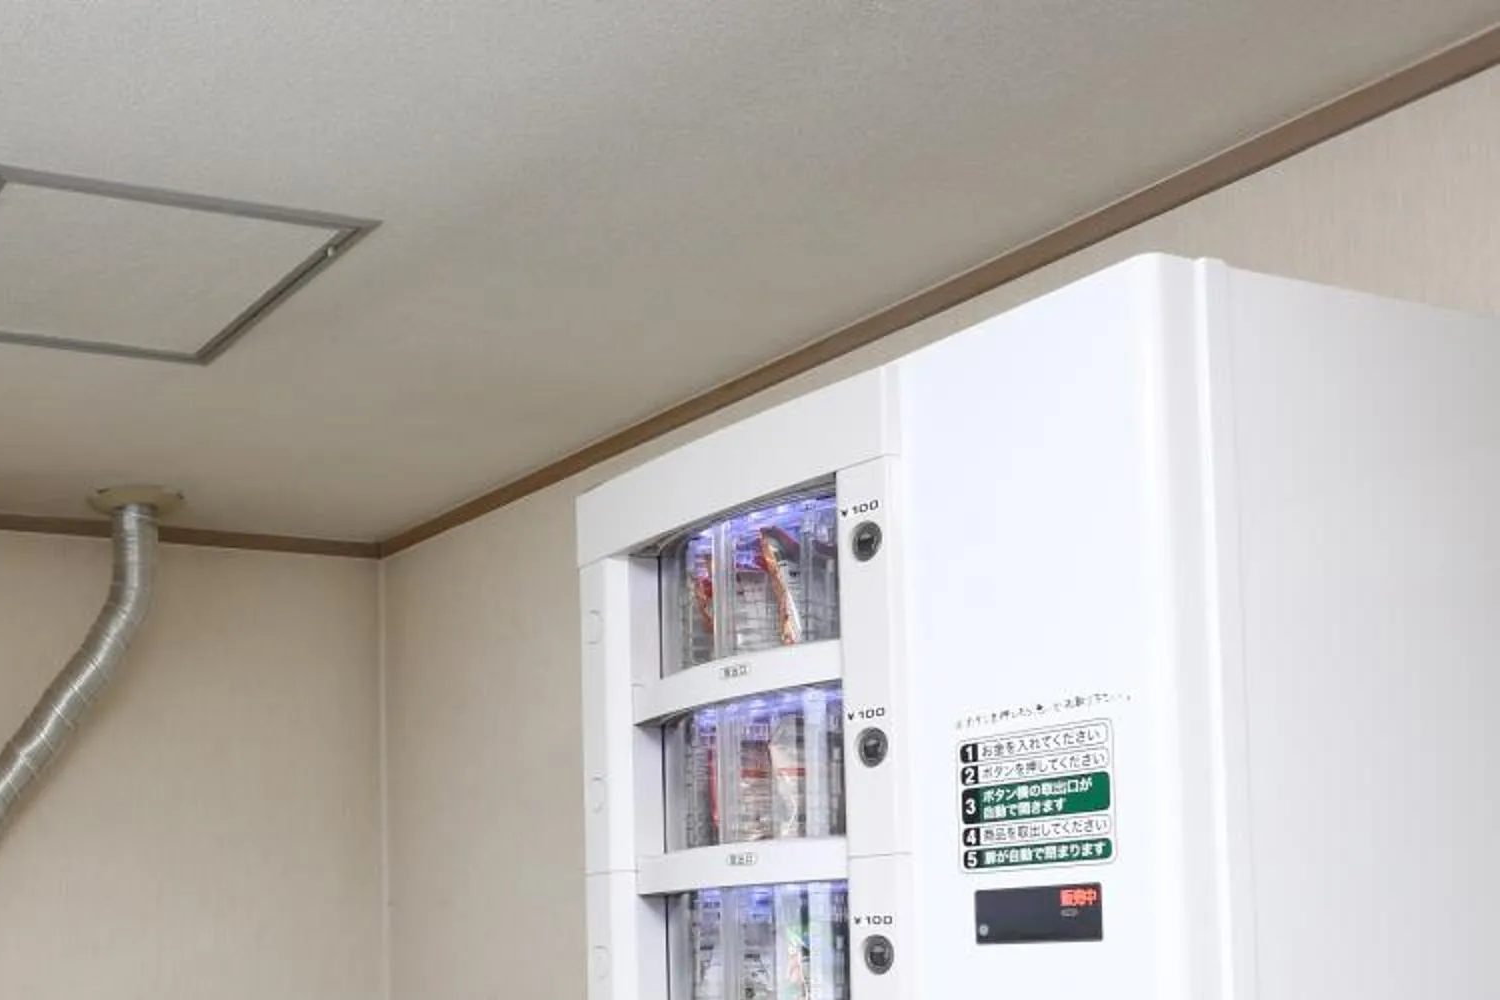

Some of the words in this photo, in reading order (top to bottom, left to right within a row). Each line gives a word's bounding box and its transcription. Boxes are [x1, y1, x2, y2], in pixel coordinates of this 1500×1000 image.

[841, 499, 879, 517] ¥100
[847, 707, 886, 720] ¥100
[982, 727, 1102, 757] お金を入れてください
[966, 745, 975, 760] 1
[982, 751, 1106, 779] ボタンを押してください
[965, 769, 975, 785] 2
[965, 798, 976, 815] 3
[965, 829, 976, 845] 4
[983, 818, 1108, 841] 商品を取出してください
[967, 851, 977, 867] 5
[854, 915, 893, 925] ¥100
